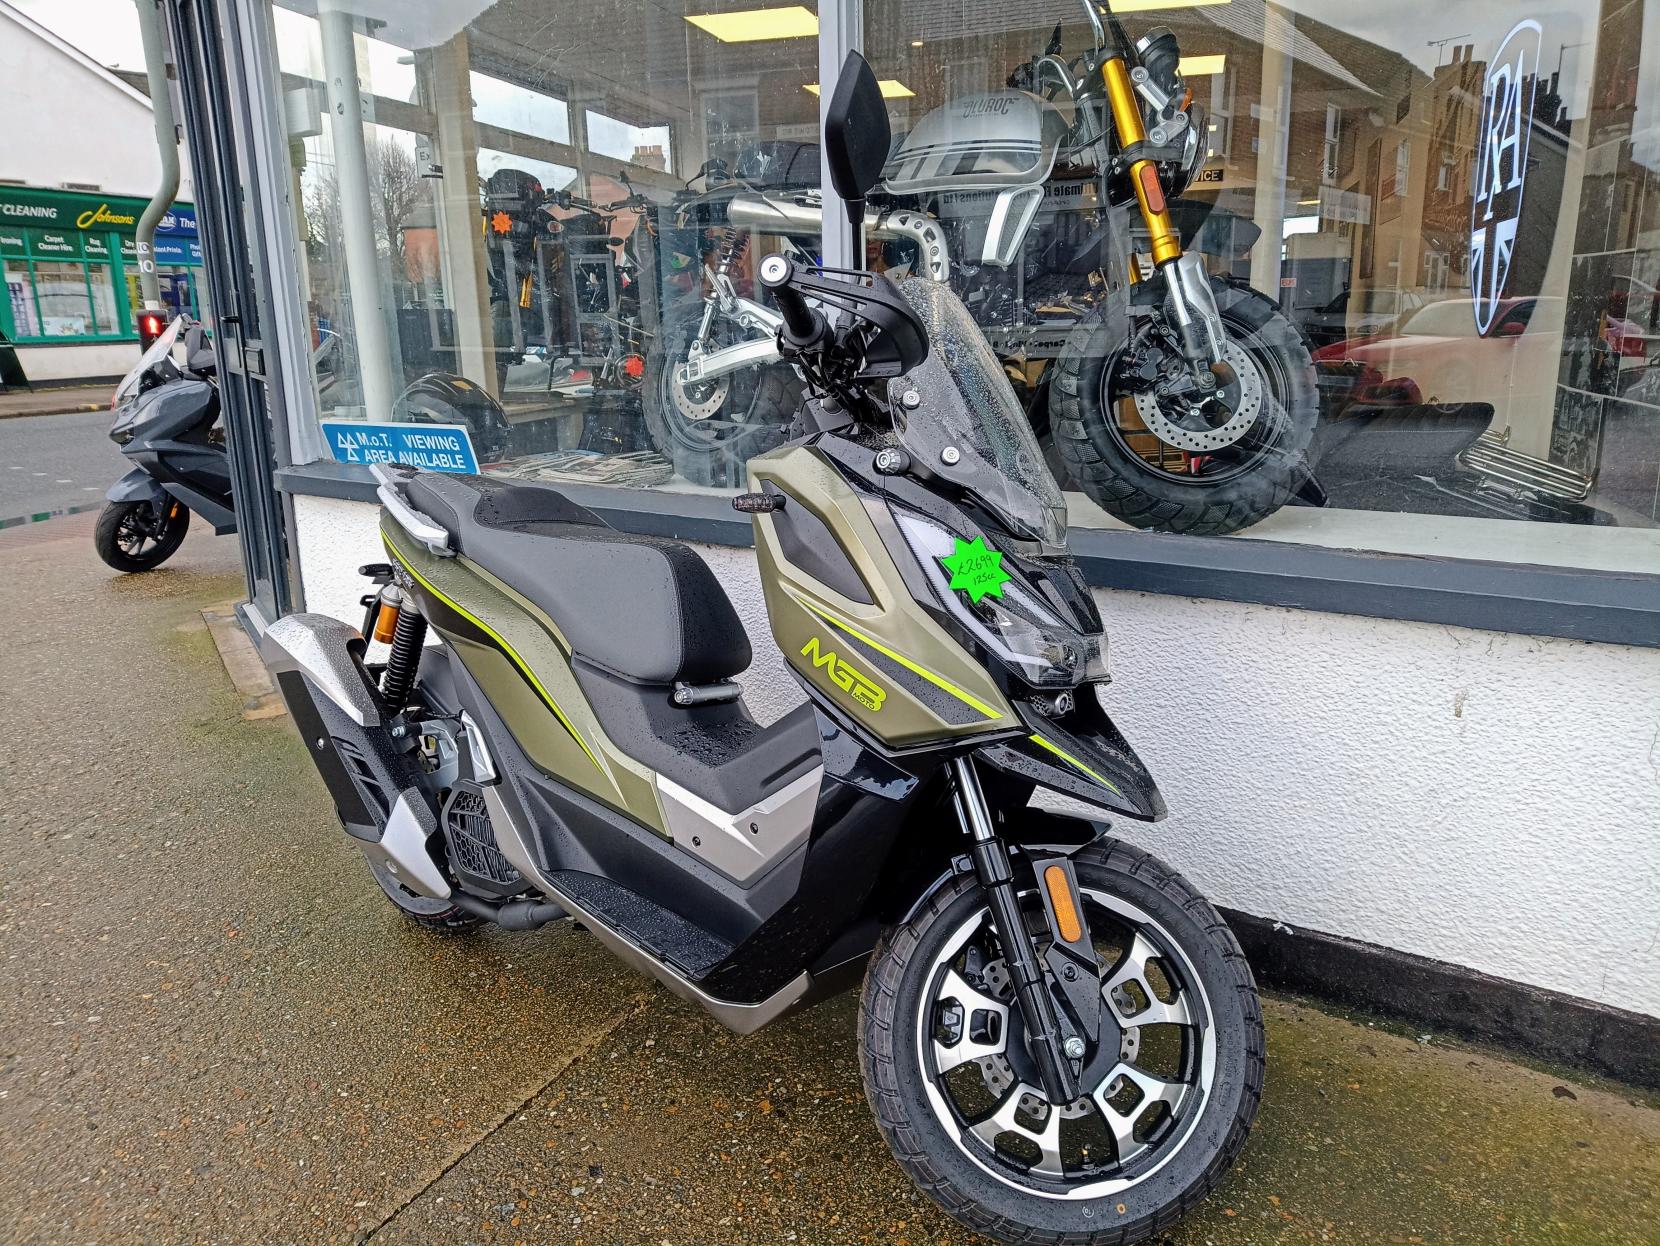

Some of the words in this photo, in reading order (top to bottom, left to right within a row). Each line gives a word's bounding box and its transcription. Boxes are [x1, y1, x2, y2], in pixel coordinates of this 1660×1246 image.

[2, 204, 58, 219] CLEANING
[77, 203, 136, 229] Johnsons
[179, 217, 196, 229] The
[402, 434, 460, 451] VIEWING
[363, 449, 396, 464] AREA
[399, 450, 466, 469] AVAILABLE
[957, 554, 995, 576] £2699
[973, 573, 997, 586] 125cc
[852, 692, 876, 710] MOTO
